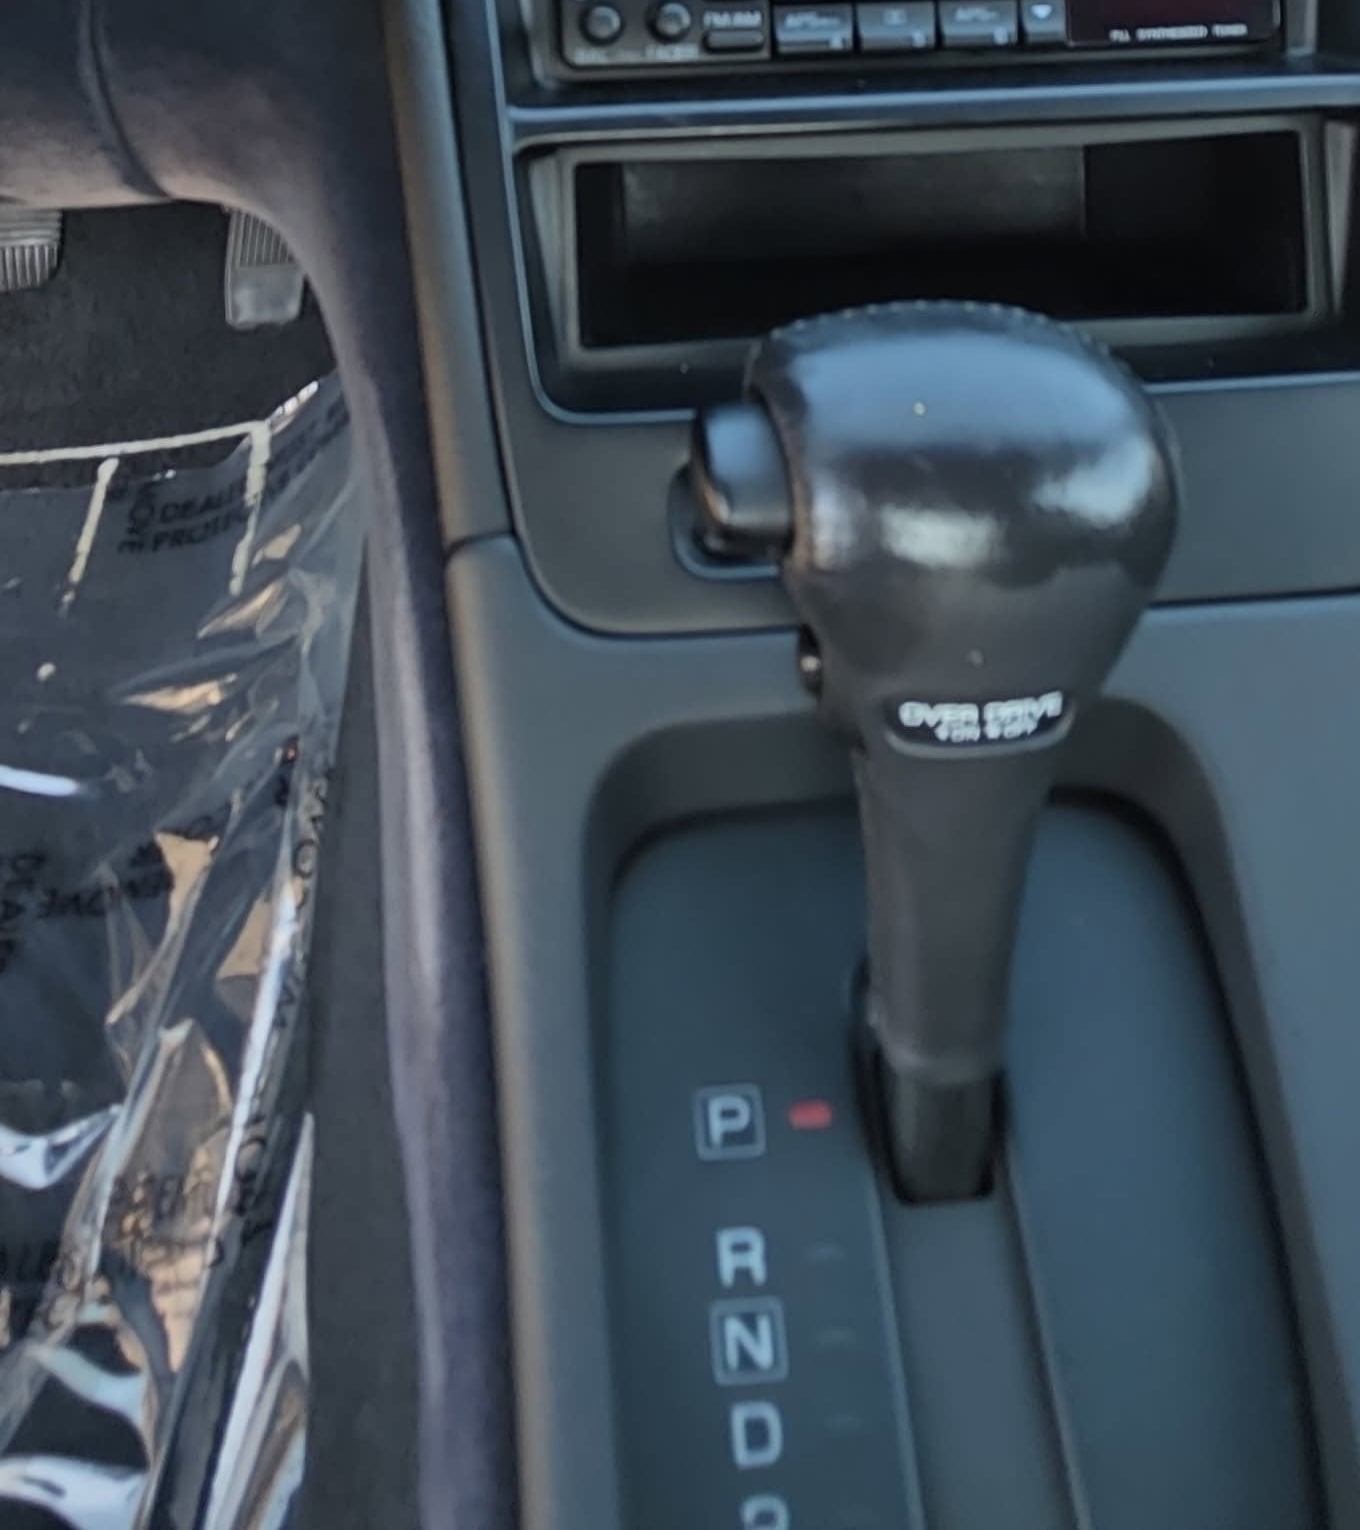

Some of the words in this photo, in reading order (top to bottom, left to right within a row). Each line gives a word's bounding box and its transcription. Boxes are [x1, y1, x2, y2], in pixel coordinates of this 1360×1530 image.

[898, 701, 979, 728] OVER
[983, 690, 1063, 722] DRIVE
[708, 1095, 752, 1149] P
[715, 1225, 768, 1289] R
[723, 1313, 775, 1372] N
[730, 1400, 784, 1468] D
